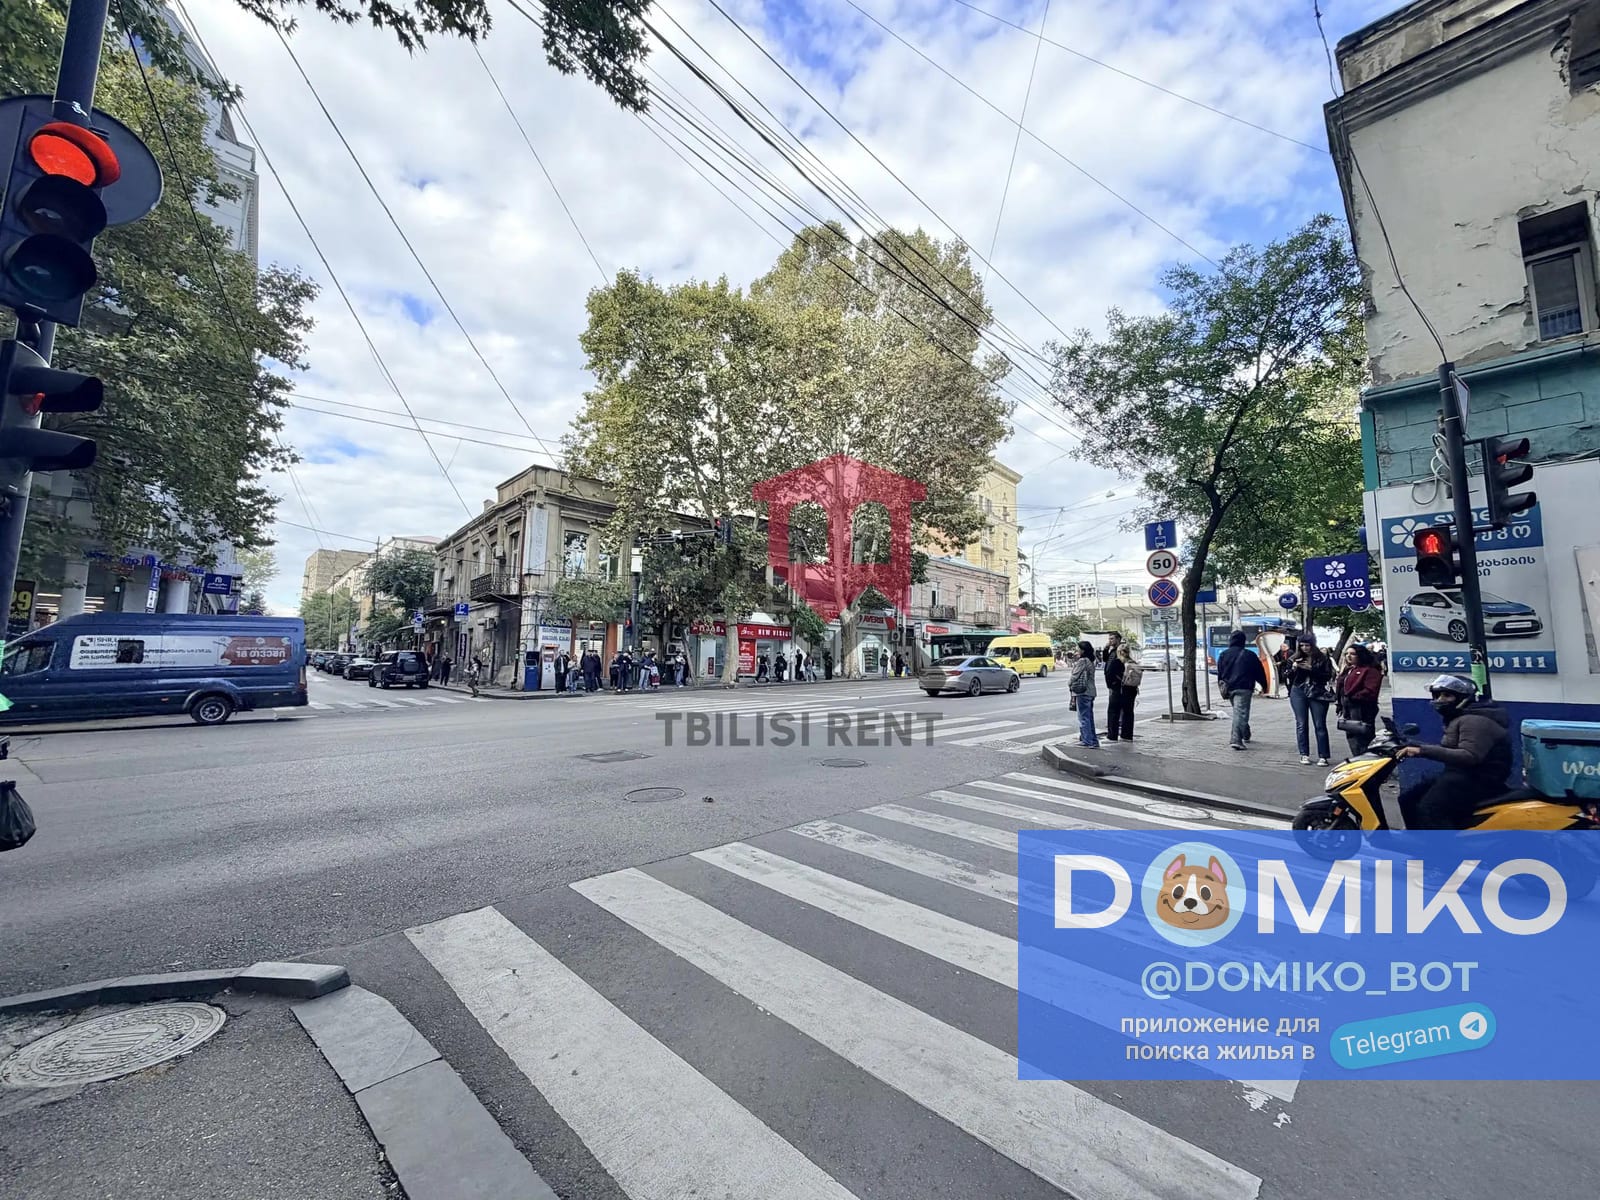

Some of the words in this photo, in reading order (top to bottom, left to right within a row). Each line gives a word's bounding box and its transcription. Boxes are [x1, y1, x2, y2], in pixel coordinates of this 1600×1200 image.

[1152, 558, 1171, 570] 50
[1477, 556, 1536, 568] ძახების
[1310, 578, 1364, 591] სინევო
[1313, 590, 1366, 603] synevo
[1416, 656, 1450, 668] 032
[1454, 657, 1465, 667] 2
[1512, 656, 1547, 668] 111
